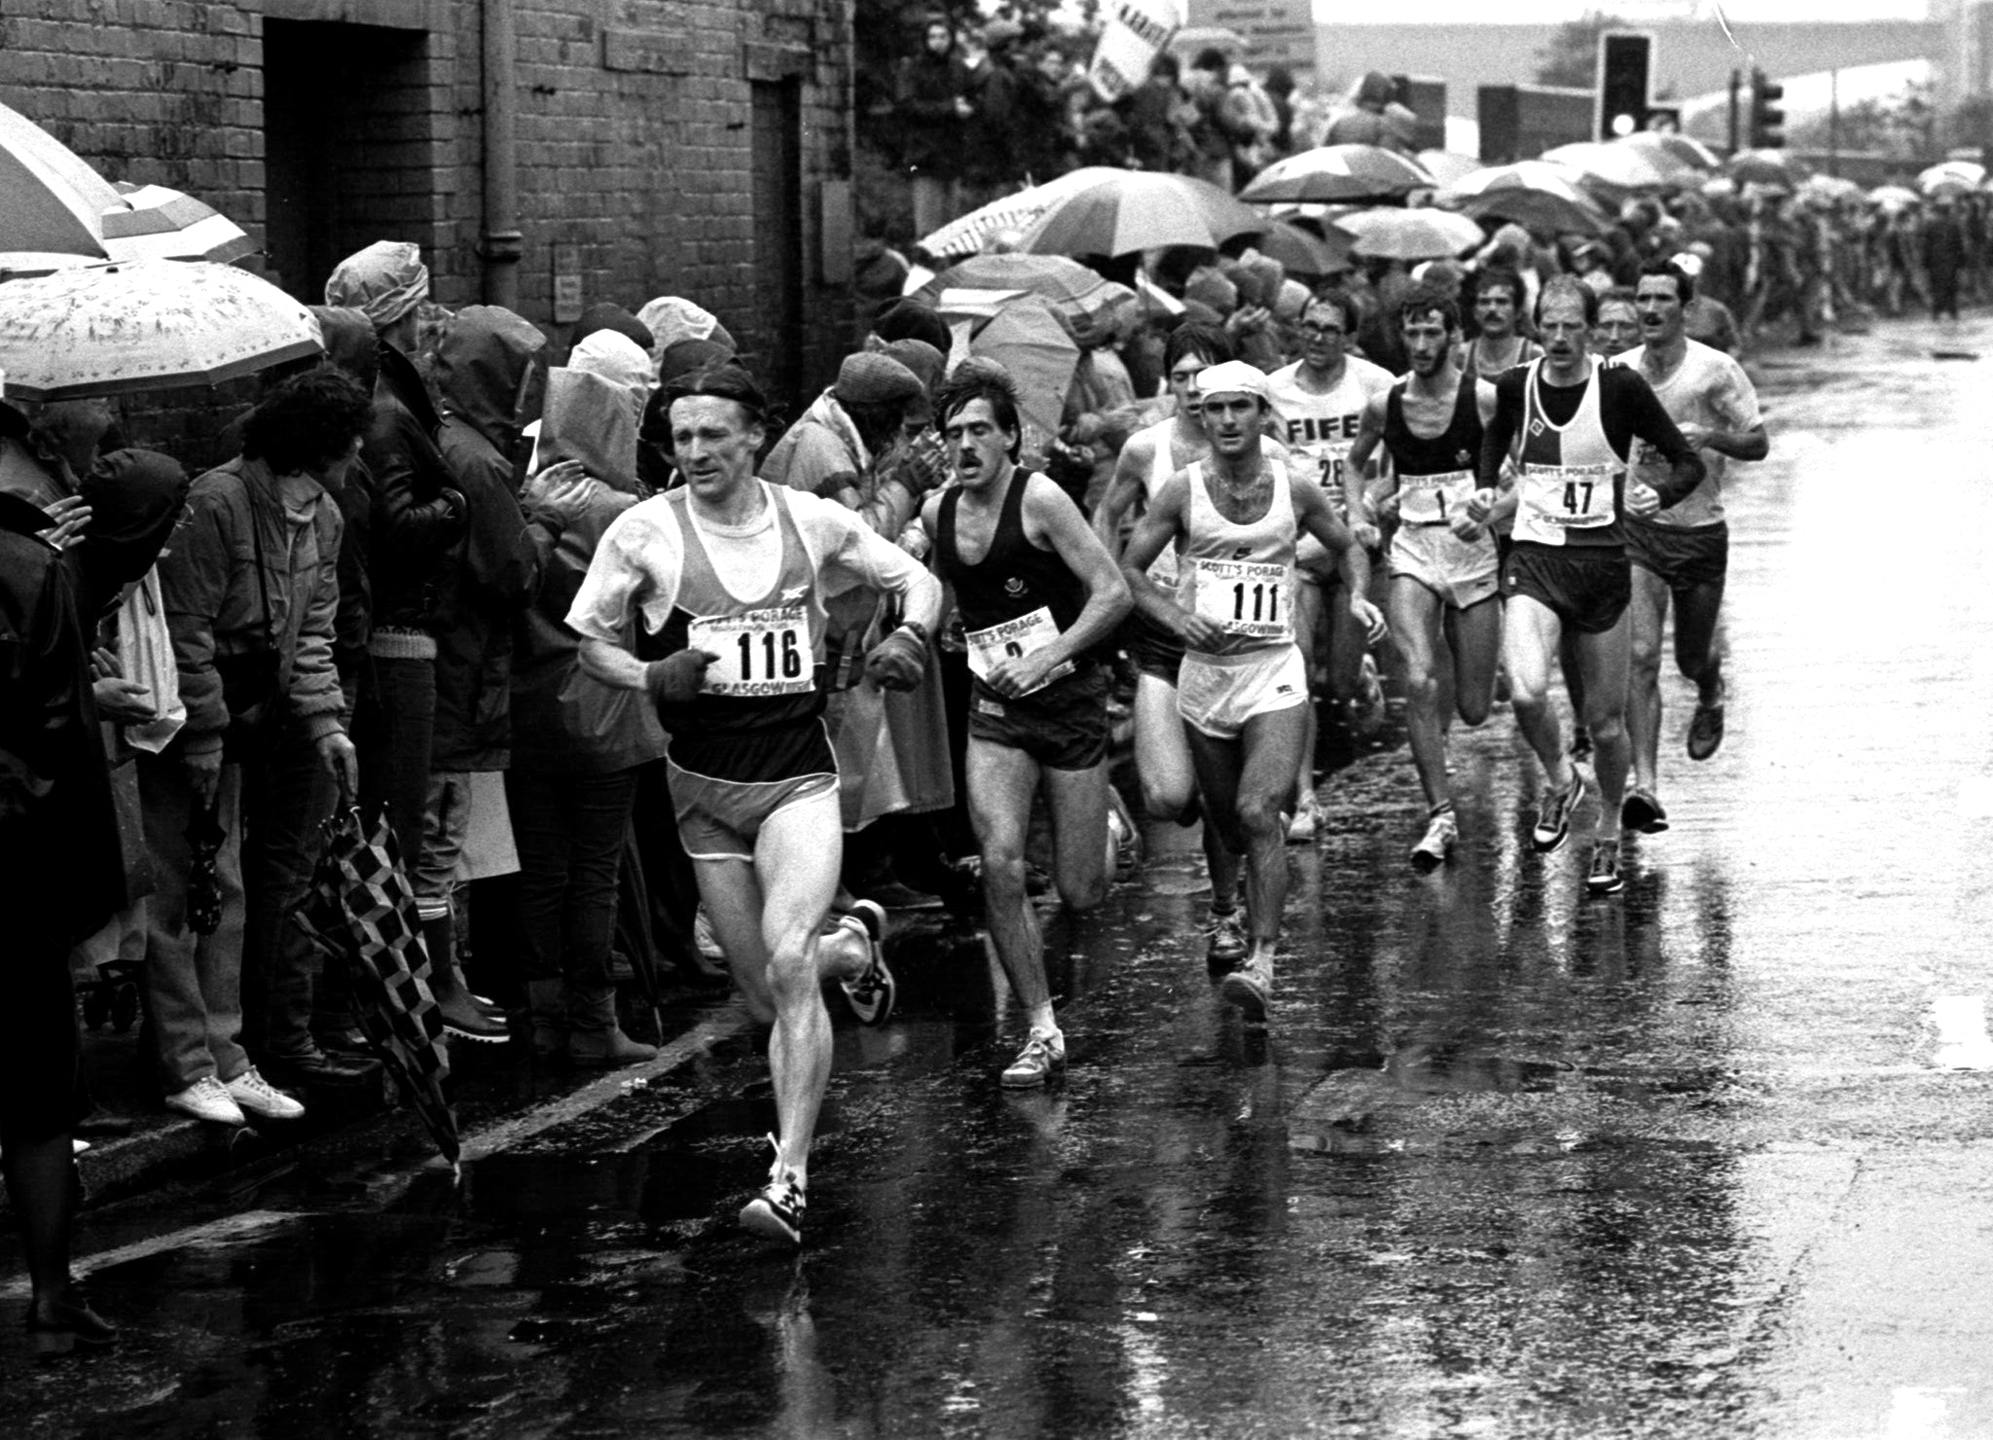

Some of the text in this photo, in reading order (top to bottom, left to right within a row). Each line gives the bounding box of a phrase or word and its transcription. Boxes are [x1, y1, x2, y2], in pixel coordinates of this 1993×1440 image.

[1287, 413, 1359, 444] FIFE
[1435, 489, 1446, 518] 1
[1563, 482, 1593, 514] 47
[1233, 583, 1278, 622] 111
[996, 612, 1044, 636] PORAGE
[737, 629, 801, 681] 116
